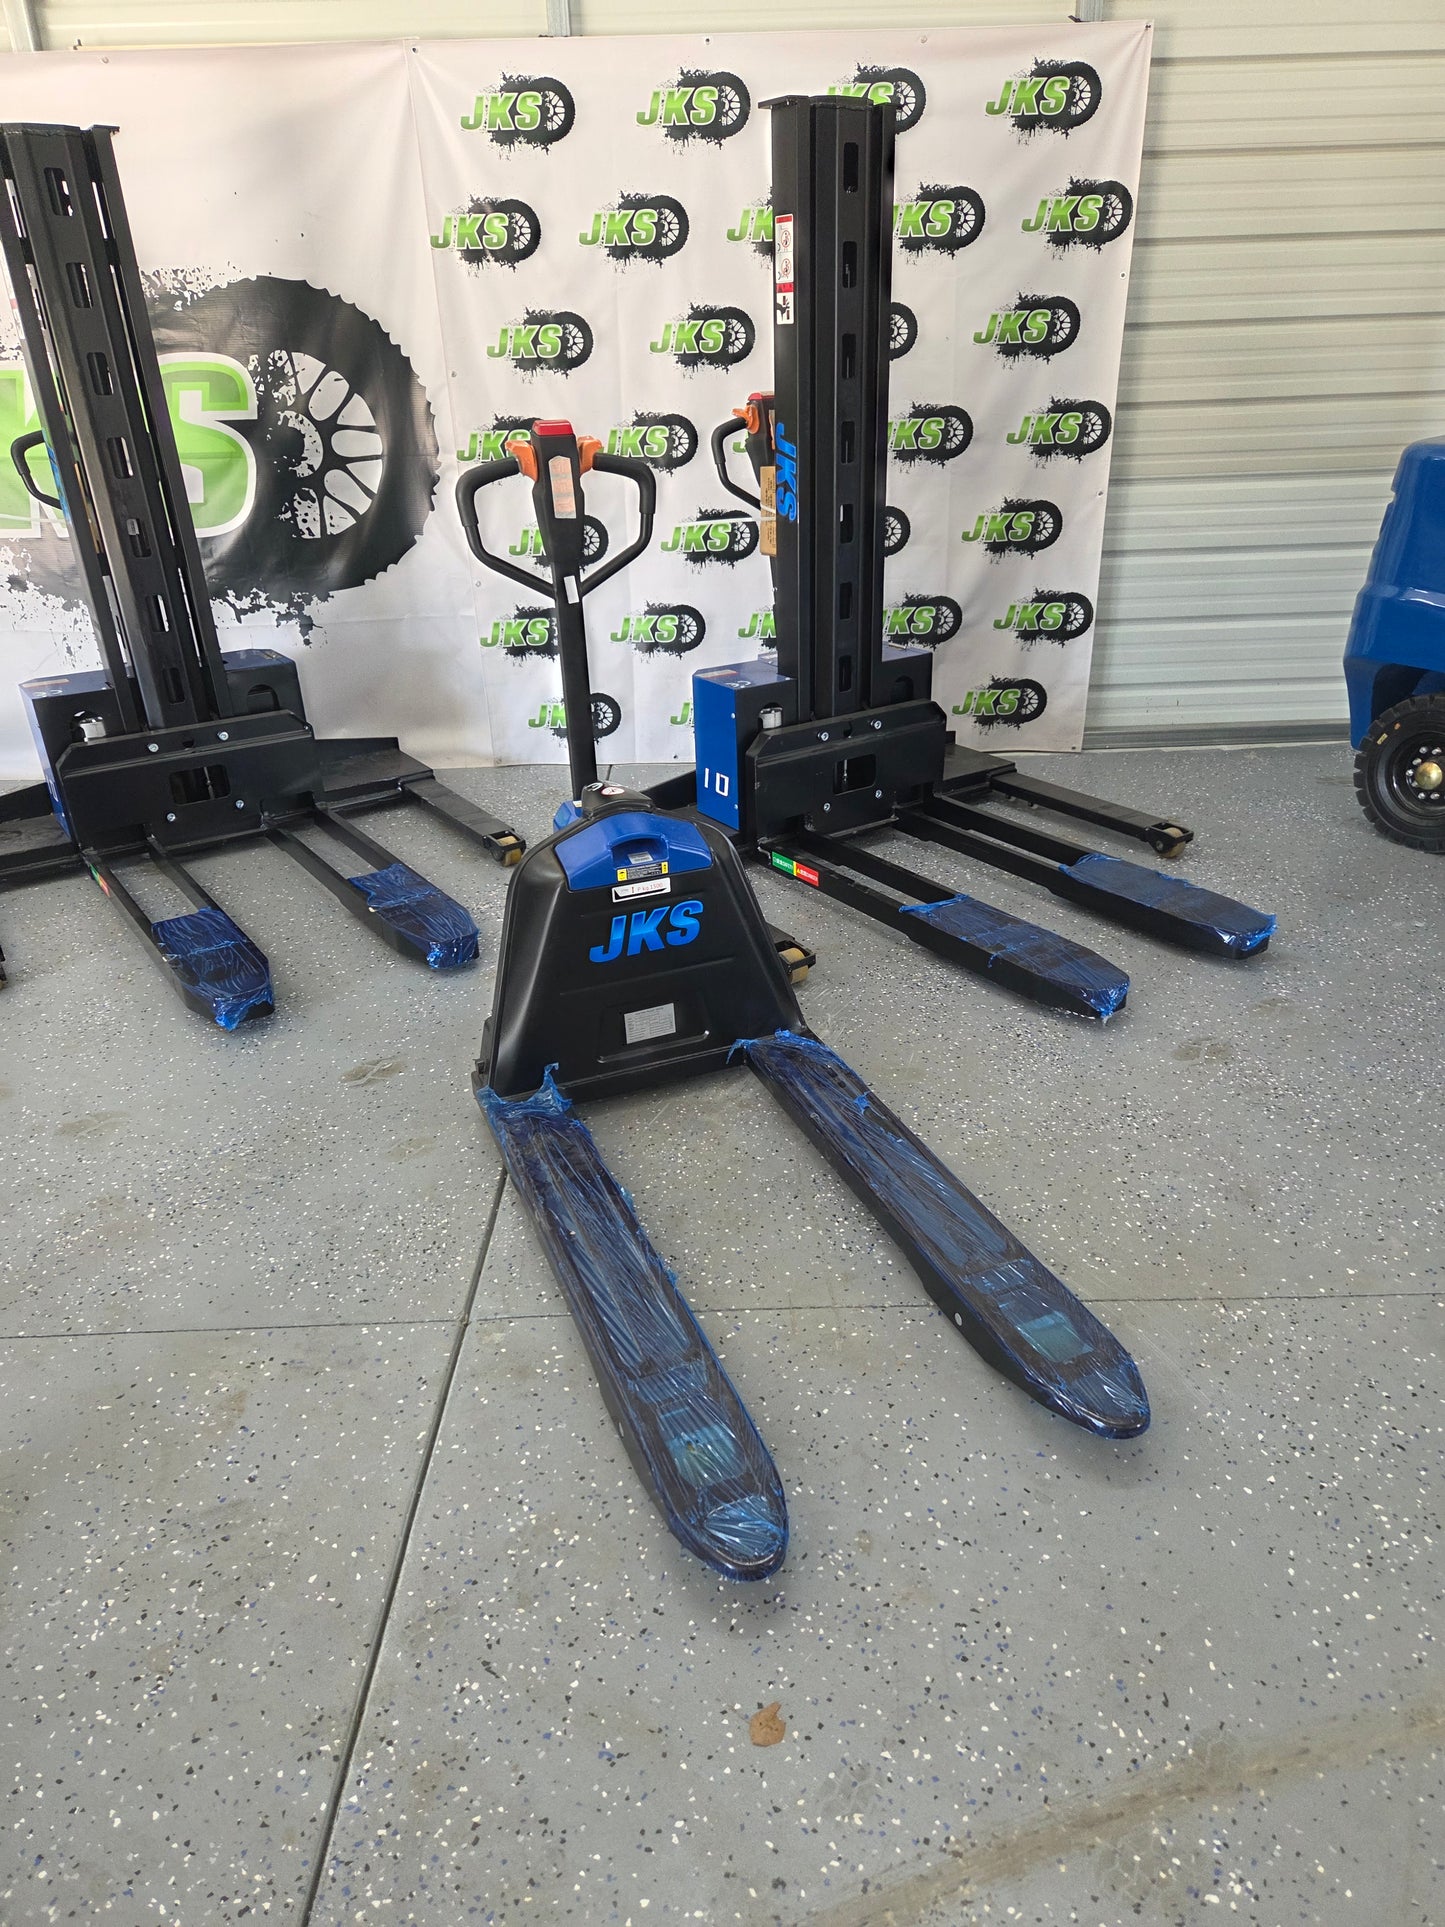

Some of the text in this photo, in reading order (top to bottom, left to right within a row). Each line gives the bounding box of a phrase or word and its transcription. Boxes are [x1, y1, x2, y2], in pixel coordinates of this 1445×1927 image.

[461, 93, 541, 129] JKS
[636, 87, 717, 126] JKS
[985, 77, 1069, 115] JKS
[579, 210, 657, 246] JKS
[726, 207, 774, 242] JK
[1021, 196, 1102, 232] JKS
[431, 214, 507, 249] JKS
[487, 325, 561, 357] JKS
[649, 320, 724, 353] JKS
[973, 310, 1050, 344] JKS
[599, 426, 669, 458] JKS
[1006, 413, 1082, 444] JKS
[775, 422, 797, 522] JKS
[661, 523, 730, 551] JKS
[962, 512, 1034, 542] JKS
[481, 619, 548, 646] JKS
[610, 616, 677, 641] JKS
[737, 611, 777, 638] JK
[993, 603, 1065, 630] JKS
[952, 688, 1020, 715] JKS
[704, 767, 730, 797] 10
[589, 900, 704, 963] JKS
